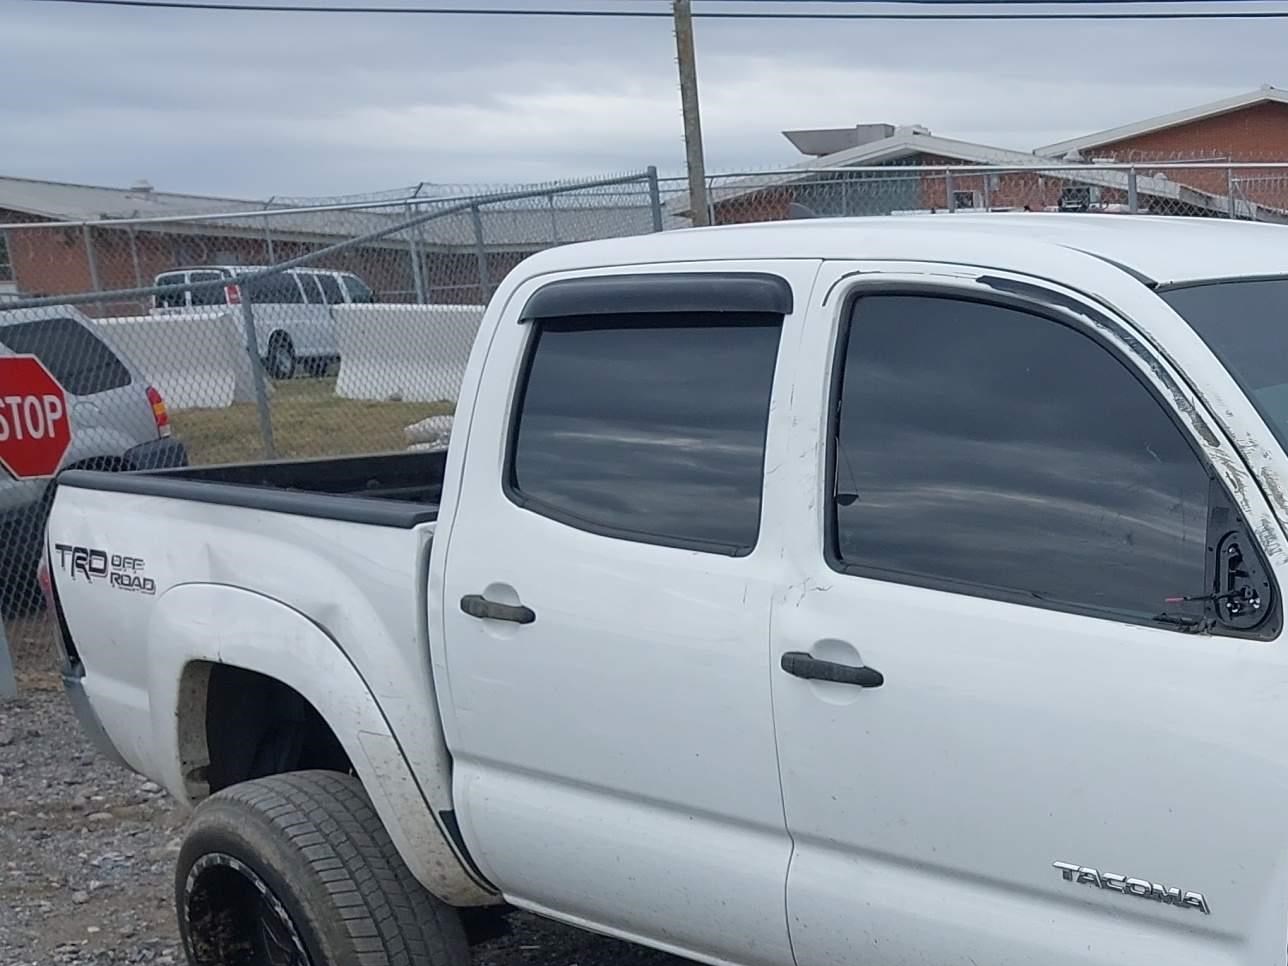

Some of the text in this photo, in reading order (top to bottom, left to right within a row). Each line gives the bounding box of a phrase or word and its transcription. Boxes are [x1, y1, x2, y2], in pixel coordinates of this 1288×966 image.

[55, 543, 145, 584] TRD OFF
[110, 572, 156, 595] ROAD
[1052, 861, 1211, 914] TACOMA
